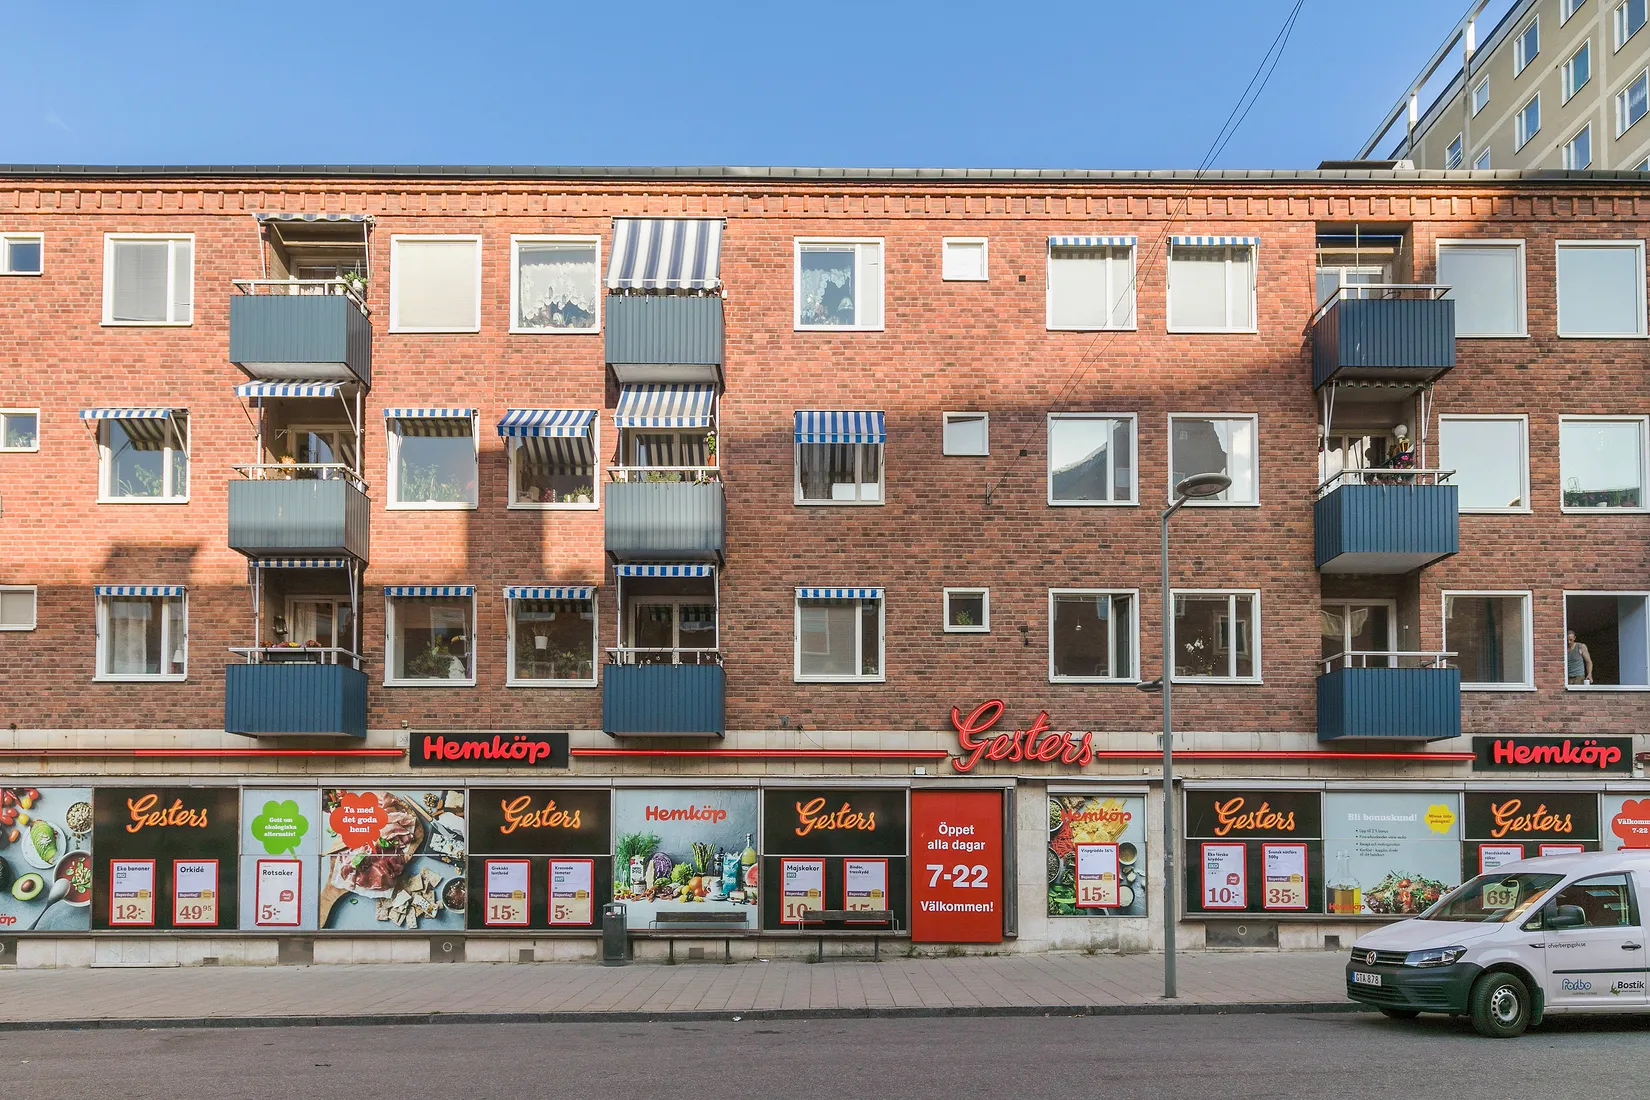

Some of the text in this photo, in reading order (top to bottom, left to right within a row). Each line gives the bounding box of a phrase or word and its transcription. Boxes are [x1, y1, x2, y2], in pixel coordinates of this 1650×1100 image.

[952, 699, 1092, 772] Gesters
[423, 735, 550, 764] Hemköp
[1494, 740, 1621, 768] Hemköp
[126, 794, 208, 833] Gesters
[500, 795, 582, 834] Gesters
[646, 805, 726, 824] Hemköp
[795, 797, 876, 836] Gesters
[1060, 808, 1132, 824] Hemköp
[1214, 797, 1296, 836] Gesters
[1363, 814, 1417, 822] bonuskund!
[1490, 799, 1572, 838] Gesters
[938, 822, 974, 836] Öppet
[927, 840, 985, 852] alla dagar
[926, 864, 988, 888] 7-22
[1209, 888, 1239, 903] 10:-
[1269, 889, 1299, 904] 35:-
[920, 902, 994, 912] Välkommen!
[1356, 973, 1379, 984] GTA 878
